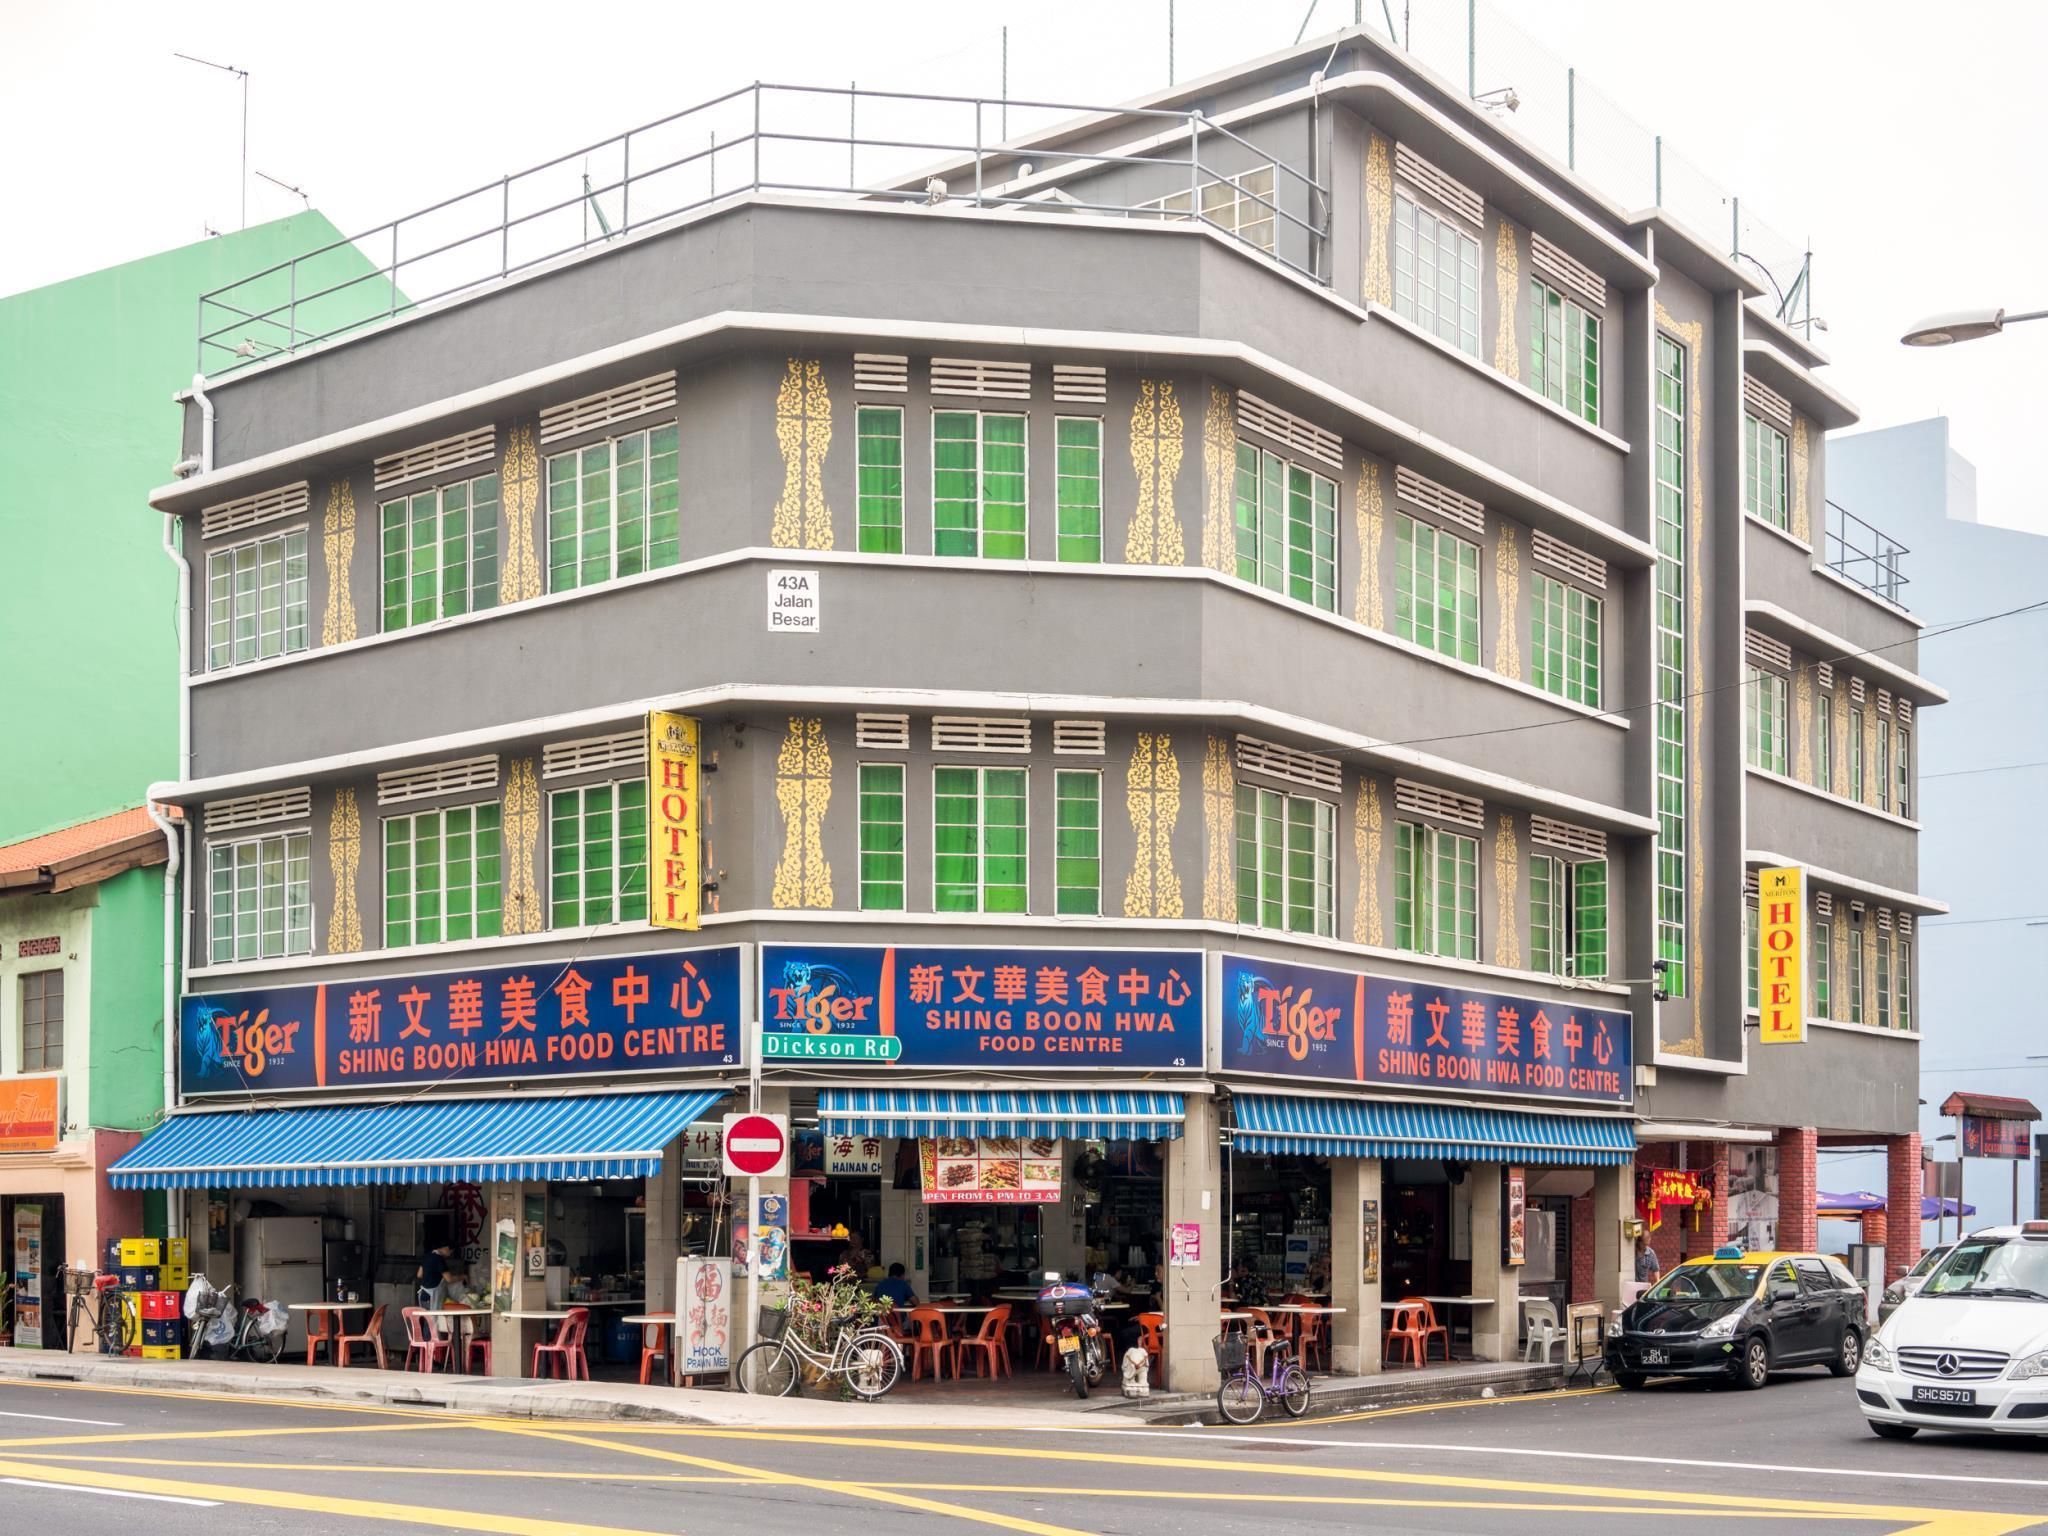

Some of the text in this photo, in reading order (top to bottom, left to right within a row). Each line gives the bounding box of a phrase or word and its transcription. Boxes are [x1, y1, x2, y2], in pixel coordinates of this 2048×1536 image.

[777, 576, 809, 590] 43A
[774, 593, 813, 608] Jalan
[772, 611, 816, 626] Besar
[661, 758, 689, 923] HOTEL
[1767, 902, 1794, 1032] HOTEL
[909, 964, 1192, 1007] 新文華美食中心
[348, 960, 712, 1045] 新文華美食中心
[768, 984, 874, 1035] Tiger
[779, 1021, 801, 1029] SINCE
[926, 1010, 1175, 1032] SHING BOON HWA
[1257, 986, 1341, 1061] Tiger
[1386, 990, 1614, 1066] 新文華美食中心
[215, 1008, 300, 1077] Tiger
[339, 1023, 726, 1074] SHING BOON HWA FOOD CENTRE
[767, 1036, 890, 1057] Dickson Rd
[979, 1036, 1123, 1052] FOOD CENTRE
[1266, 1039, 1327, 1052] SINCE 1932
[223, 1057, 285, 1068] SINCE 1932
[722, 1053, 734, 1064] 43
[1173, 1058, 1185, 1066] 43
[1378, 1048, 1620, 1093] SHING BOON HWA FOOD CENTRE
[833, 1135, 880, 1159] 海南
[832, 1162, 868, 1173] HAINAN
[951, 1192, 982, 1200] FROM
[986, 1192, 993, 1200] 6
[997, 1192, 1014, 1200] PM
[1018, 1192, 1031, 1200] TO
[1035, 1192, 1042, 1200] 3
[692, 1346, 722, 1357] HOCK
[1642, 1355, 1669, 1364] 2304T
[687, 1357, 728, 1369] PRAWN MEE
